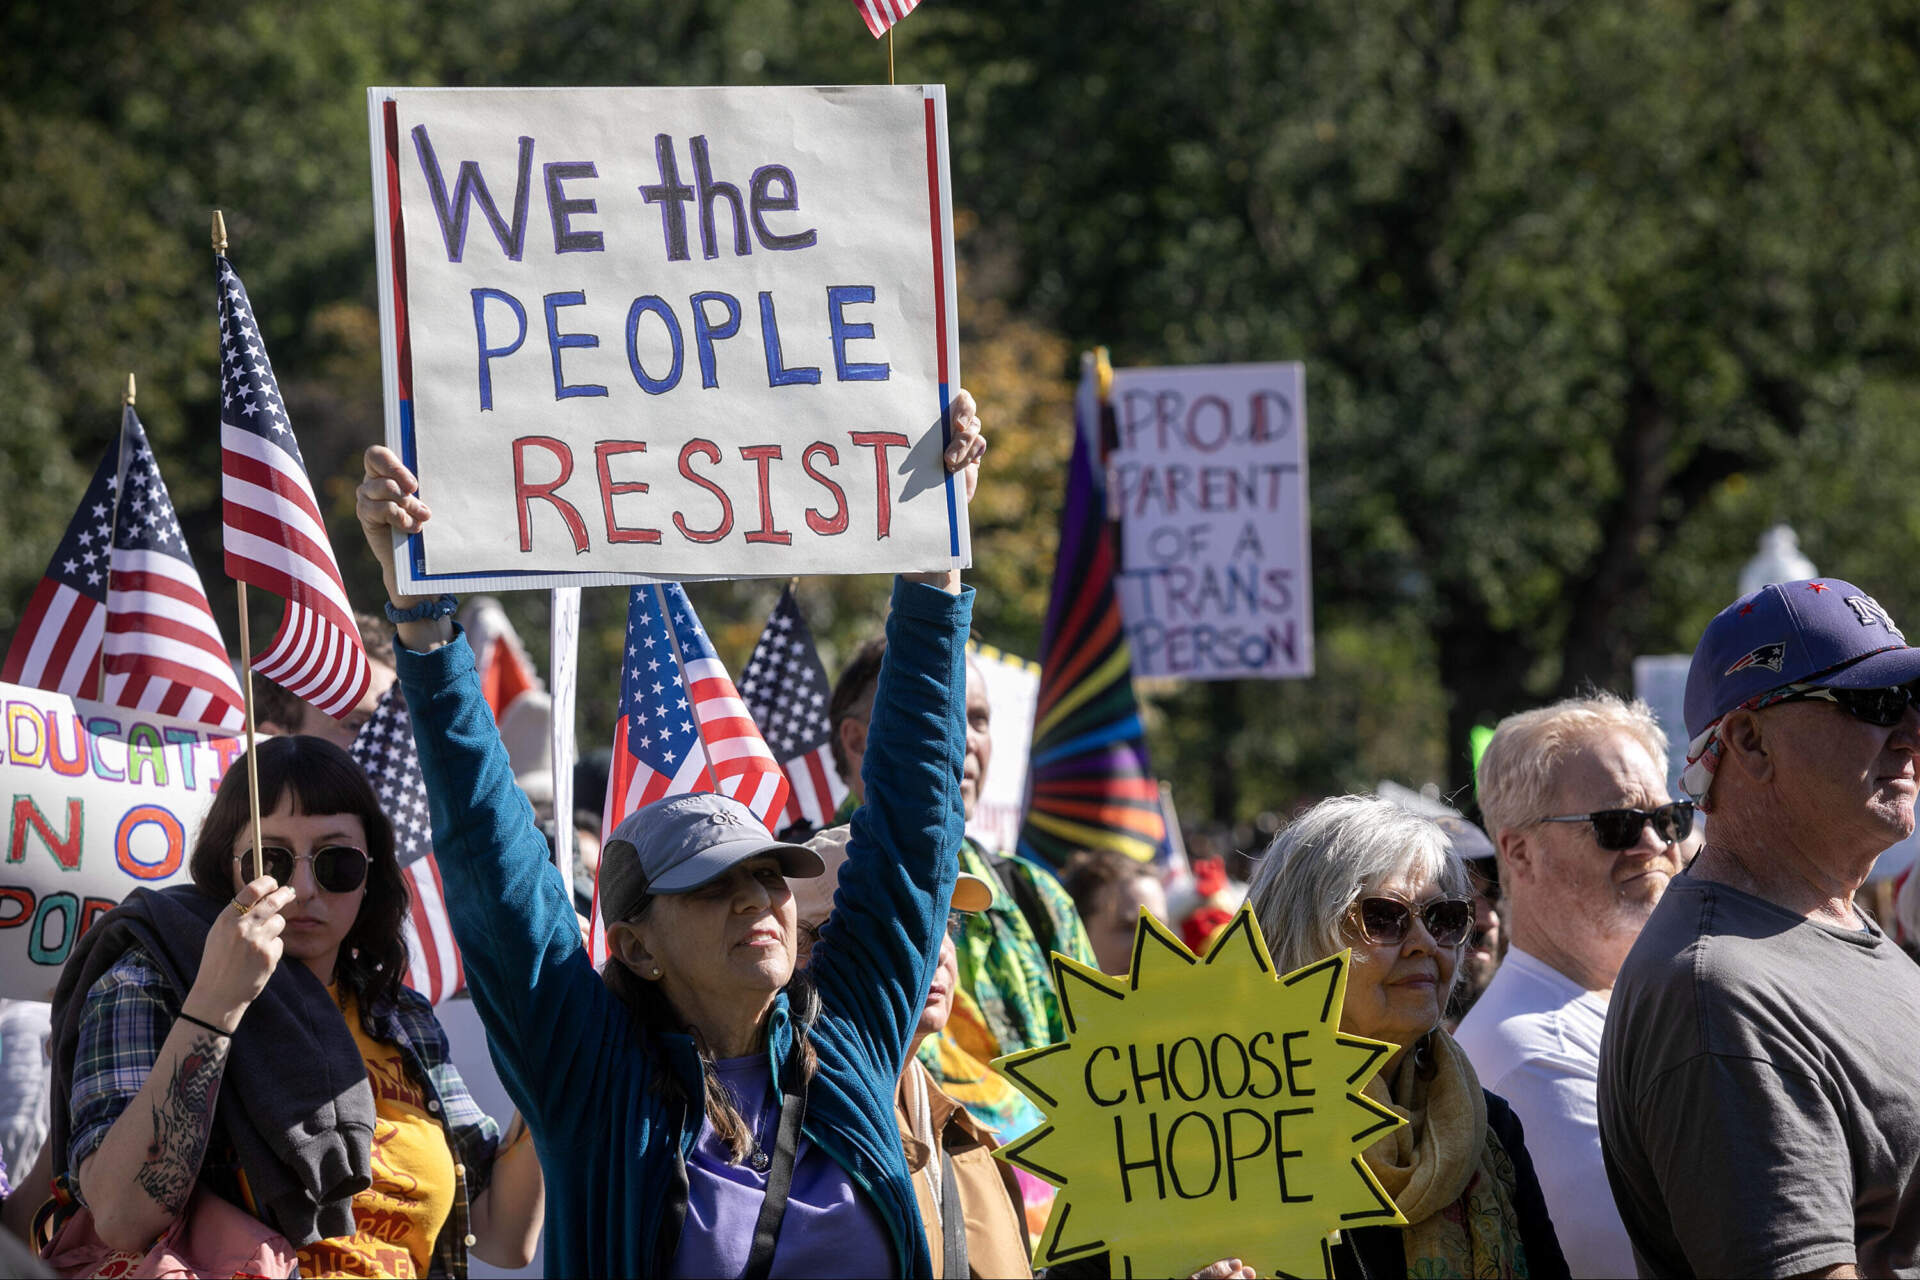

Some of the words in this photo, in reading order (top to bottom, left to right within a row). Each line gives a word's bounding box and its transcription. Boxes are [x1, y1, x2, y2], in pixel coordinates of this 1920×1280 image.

[411, 124, 604, 263] WE
[638, 133, 818, 261] the
[470, 285, 893, 412] PEOPLE
[1122, 387, 1293, 452] PROUD
[512, 431, 910, 555] RESIST
[1117, 462, 1298, 519] PARENT
[1148, 522, 1211, 563] OF
[1231, 522, 1265, 560] A
[1117, 566, 1293, 615] TRANS
[1129, 620, 1297, 676] PERSON
[0, 700, 242, 794] DUCATI
[1084, 1030, 1316, 1107] CHOOSE
[1114, 1107, 1315, 1203] HOPE
